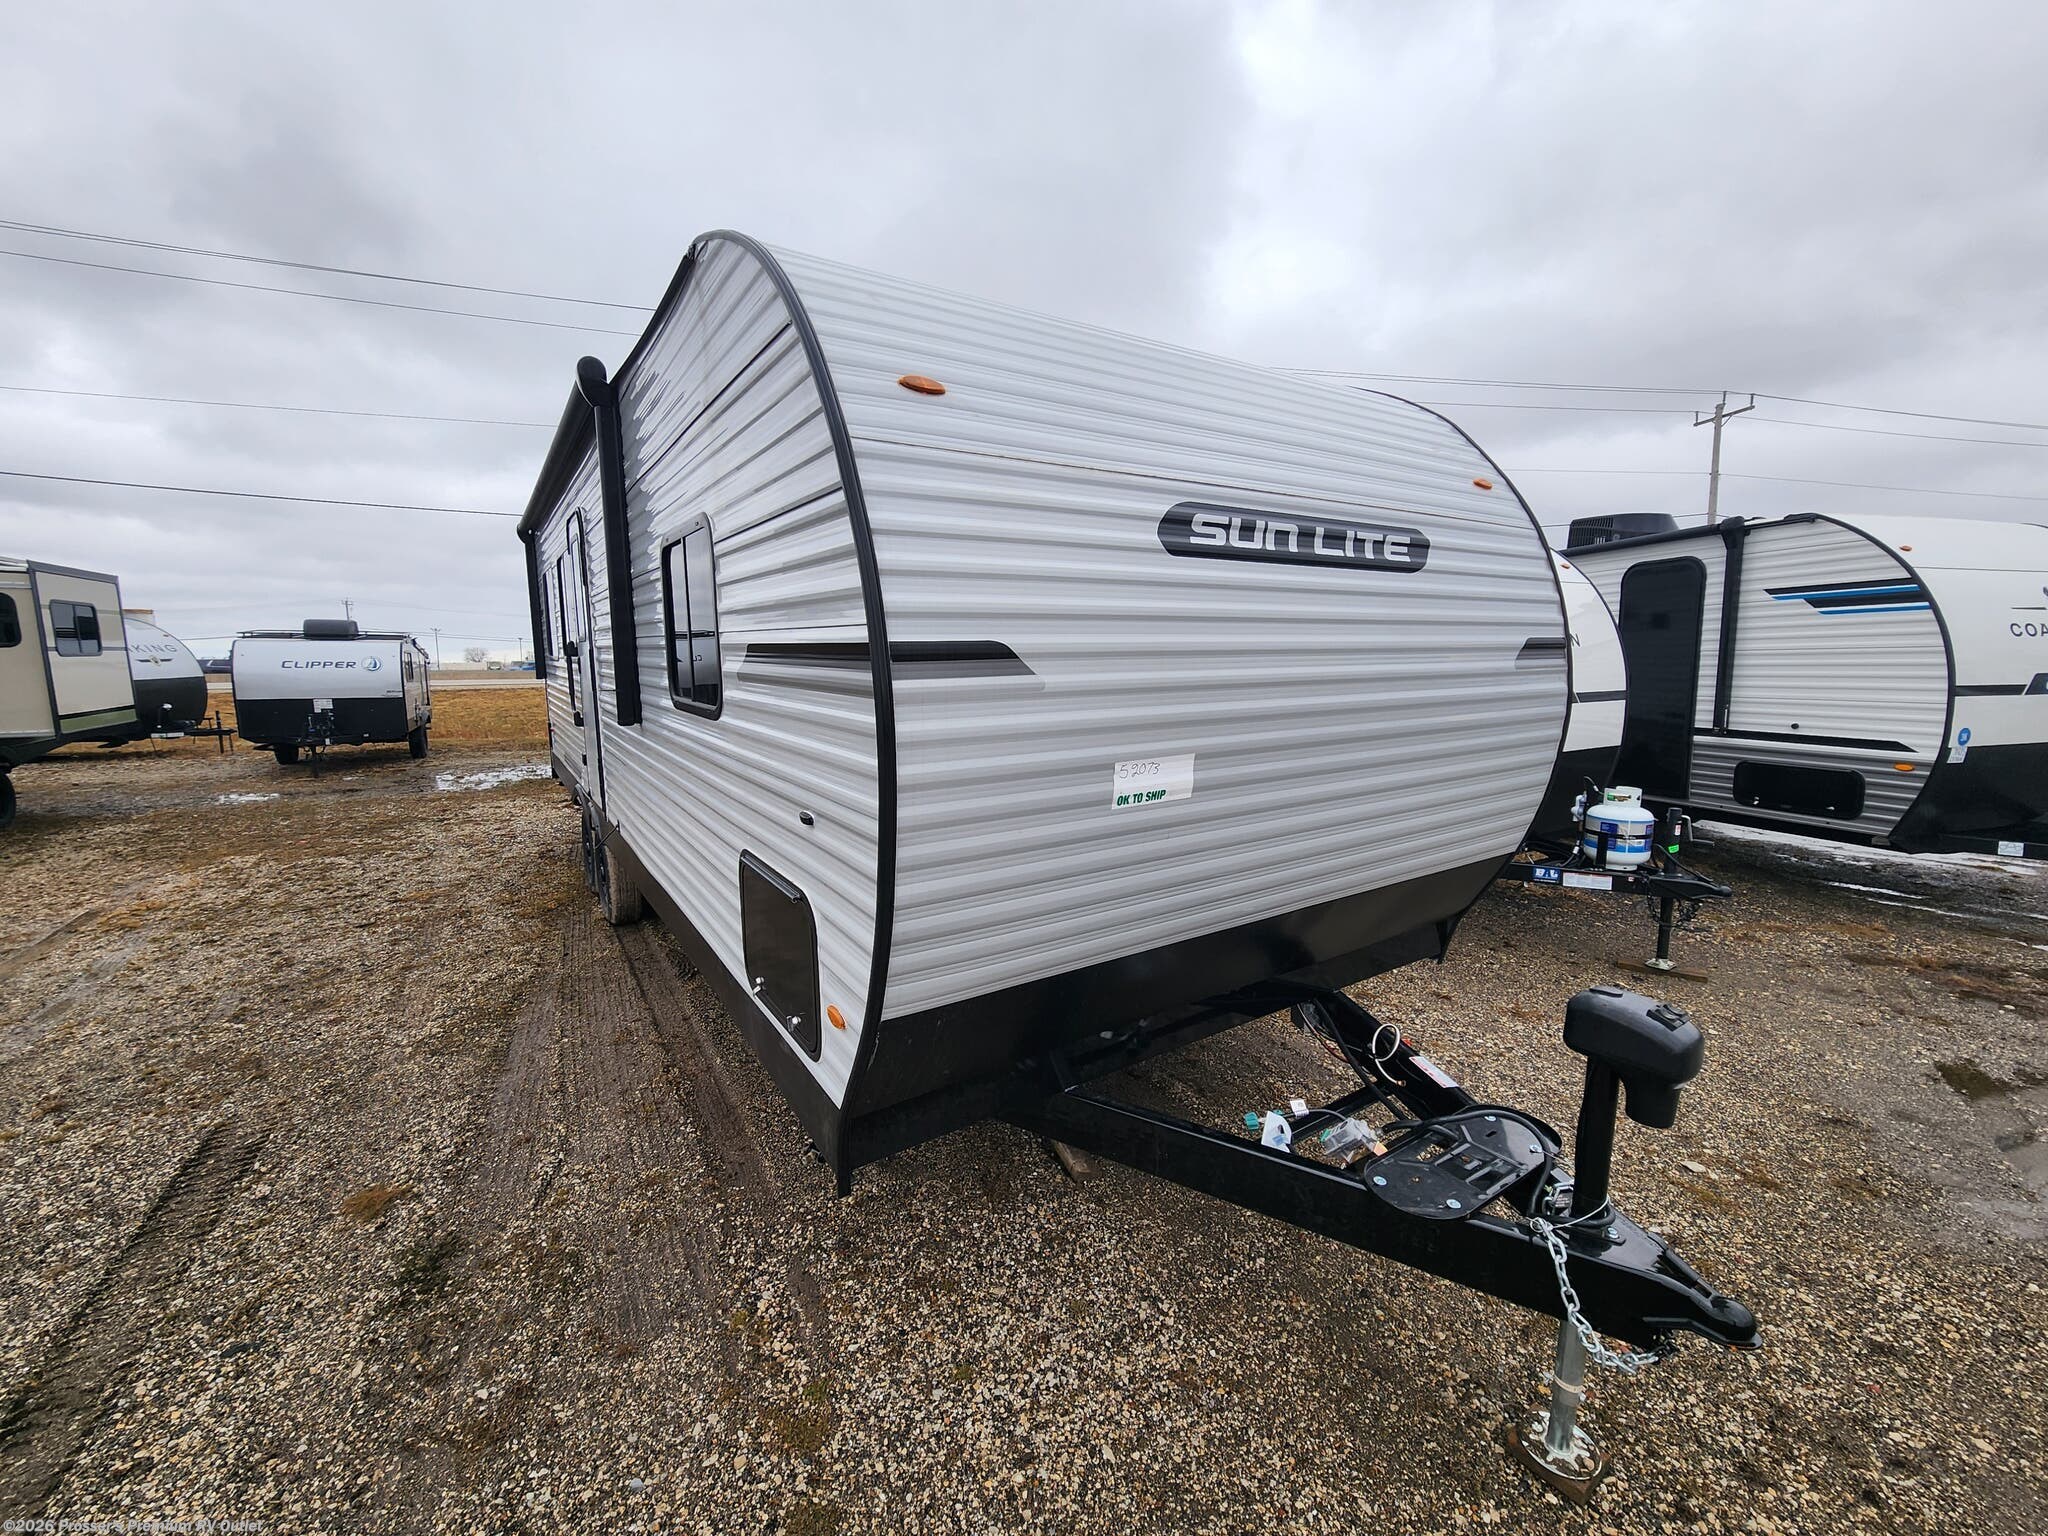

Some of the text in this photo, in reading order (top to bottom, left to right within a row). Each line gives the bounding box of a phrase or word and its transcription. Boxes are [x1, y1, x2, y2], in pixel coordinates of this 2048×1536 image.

[1190, 513, 1411, 562] SUN LITE
[281, 660, 357, 669] CLIPPER
[1119, 761, 1160, 779] 52073
[1116, 789, 1167, 807] OK TO SHIP
